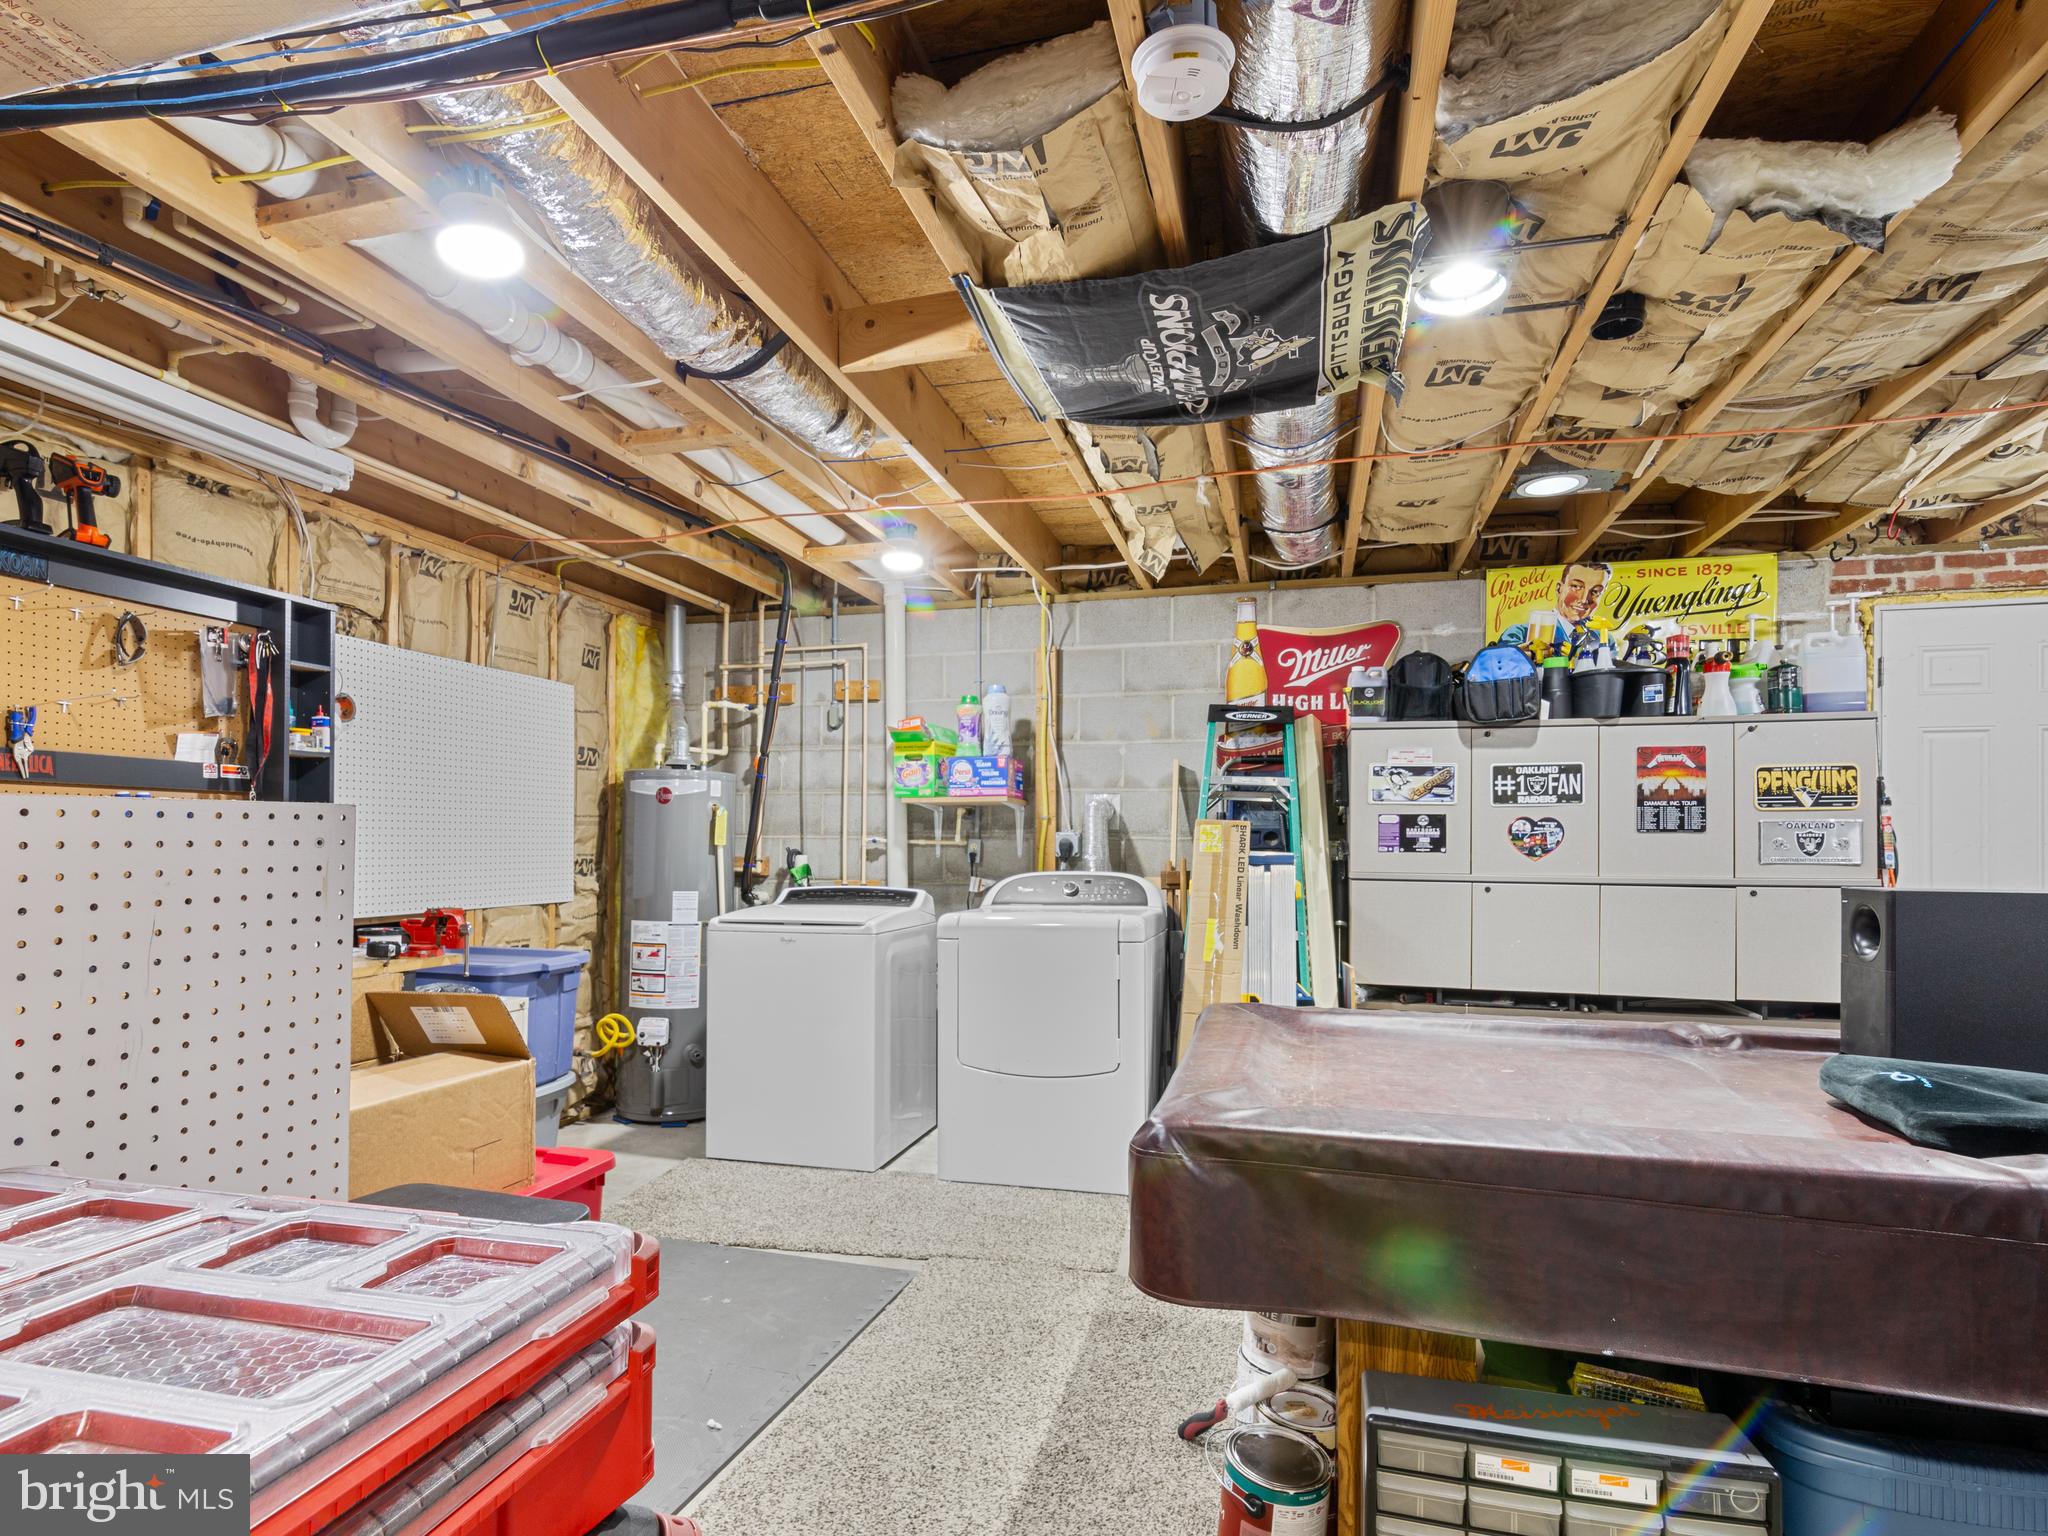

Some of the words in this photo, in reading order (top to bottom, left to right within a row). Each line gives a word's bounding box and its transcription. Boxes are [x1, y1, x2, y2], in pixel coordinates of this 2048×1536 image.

[1359, 210, 1415, 376] PENGUINS
[1330, 250, 1357, 382] PITTSBURGH
[1140, 338, 1161, 361] CUP
[1424, 364, 1492, 388] JM
[1636, 566, 1689, 578] SINCE
[1696, 563, 1733, 577] 1829
[1490, 572, 1516, 599] An
[1519, 568, 1550, 586] old
[508, 589, 536, 617] JM
[1495, 575, 1553, 632] friend
[1604, 572, 1769, 631] Yuengling's
[1680, 622, 1749, 636] TSVILLE
[1277, 643, 1373, 684] Miller
[1272, 692, 1324, 711] HIGH
[1235, 712, 1269, 721] WERNER
[1515, 765, 1559, 775] OAKLAND
[1757, 769, 1858, 794] PENGUINS
[1494, 774, 1529, 796] #1
[1548, 773, 1582, 796] FAN
[1517, 794, 1558, 804] RAIDERS
[1785, 821, 1837, 830] OAKLAND
[1237, 824, 1248, 854] SHARK
[1237, 856, 1246, 873] LED
[1234, 875, 1245, 901] Linear
[1232, 903, 1244, 950] Washdown
